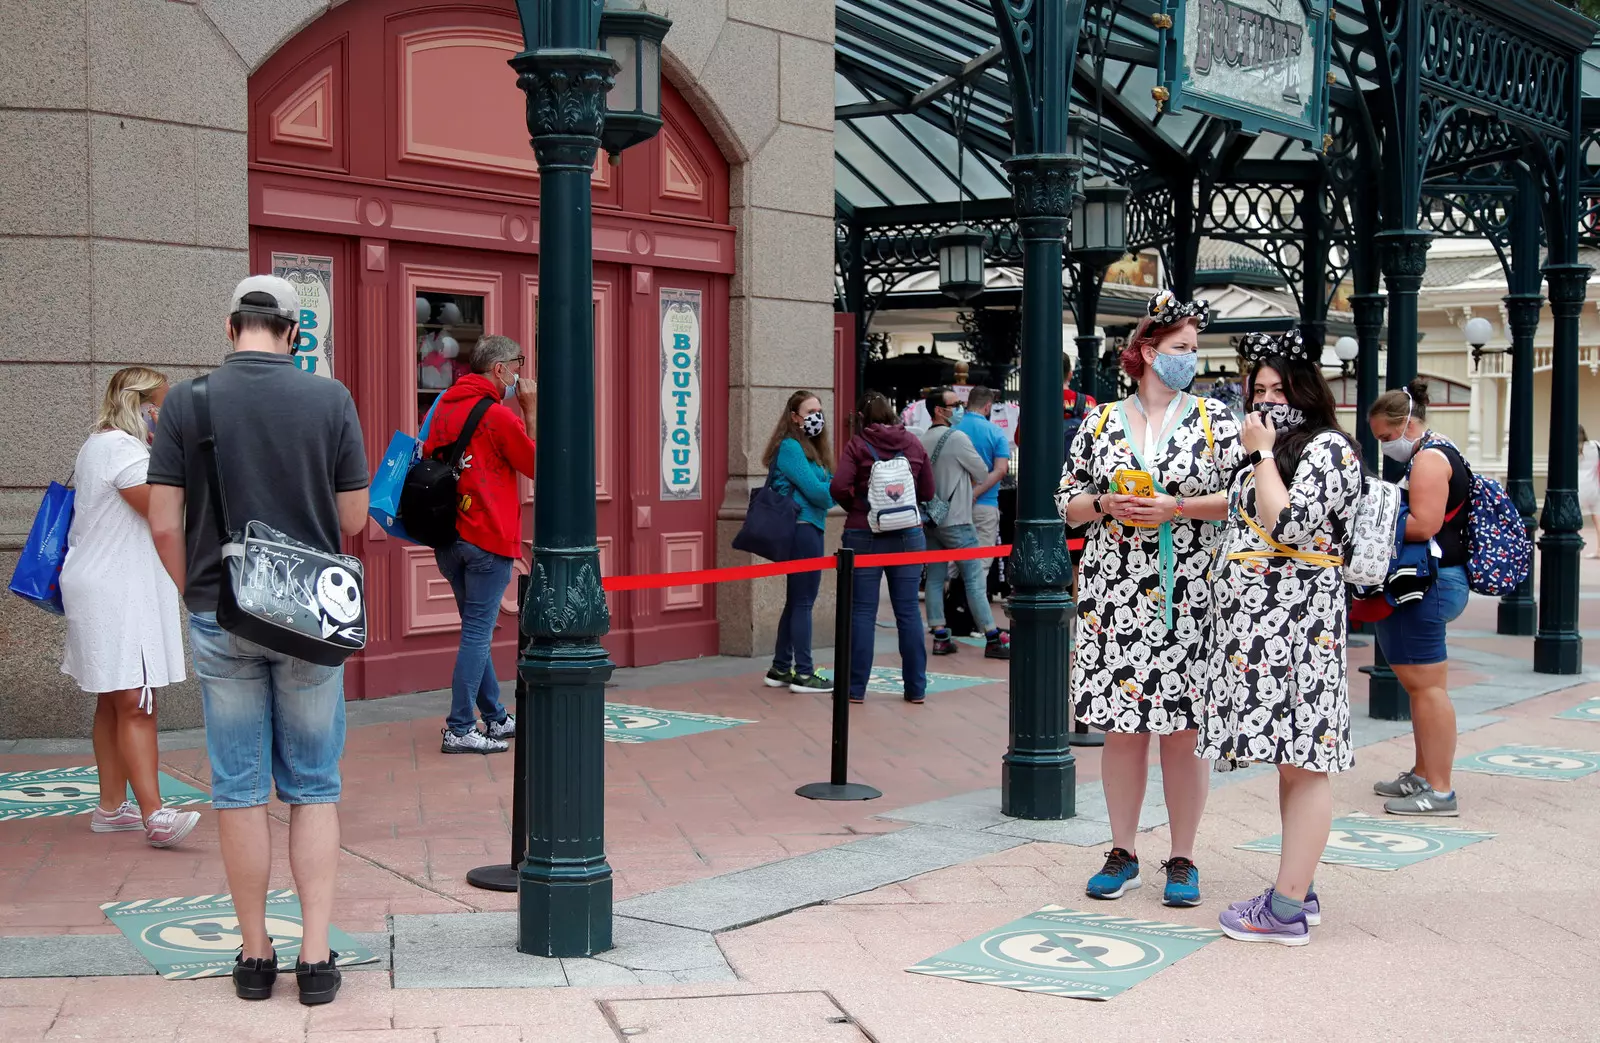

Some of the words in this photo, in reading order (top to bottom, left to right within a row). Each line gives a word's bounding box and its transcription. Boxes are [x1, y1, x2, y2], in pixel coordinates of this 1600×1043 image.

[672, 333, 691, 485] BOUTIQUE
[262, 547, 289, 559] Pumpkin
[291, 553, 305, 564] King
[1416, 798, 1433, 812] N
[115, 907, 164, 916] PLEASE
[1034, 913, 1080, 924] PLEASE
[1129, 927, 1169, 937] STAND
[1171, 932, 1206, 941] HERE
[934, 960, 1003, 975] DISTANCE
[1024, 975, 1111, 992] RESPECTER
